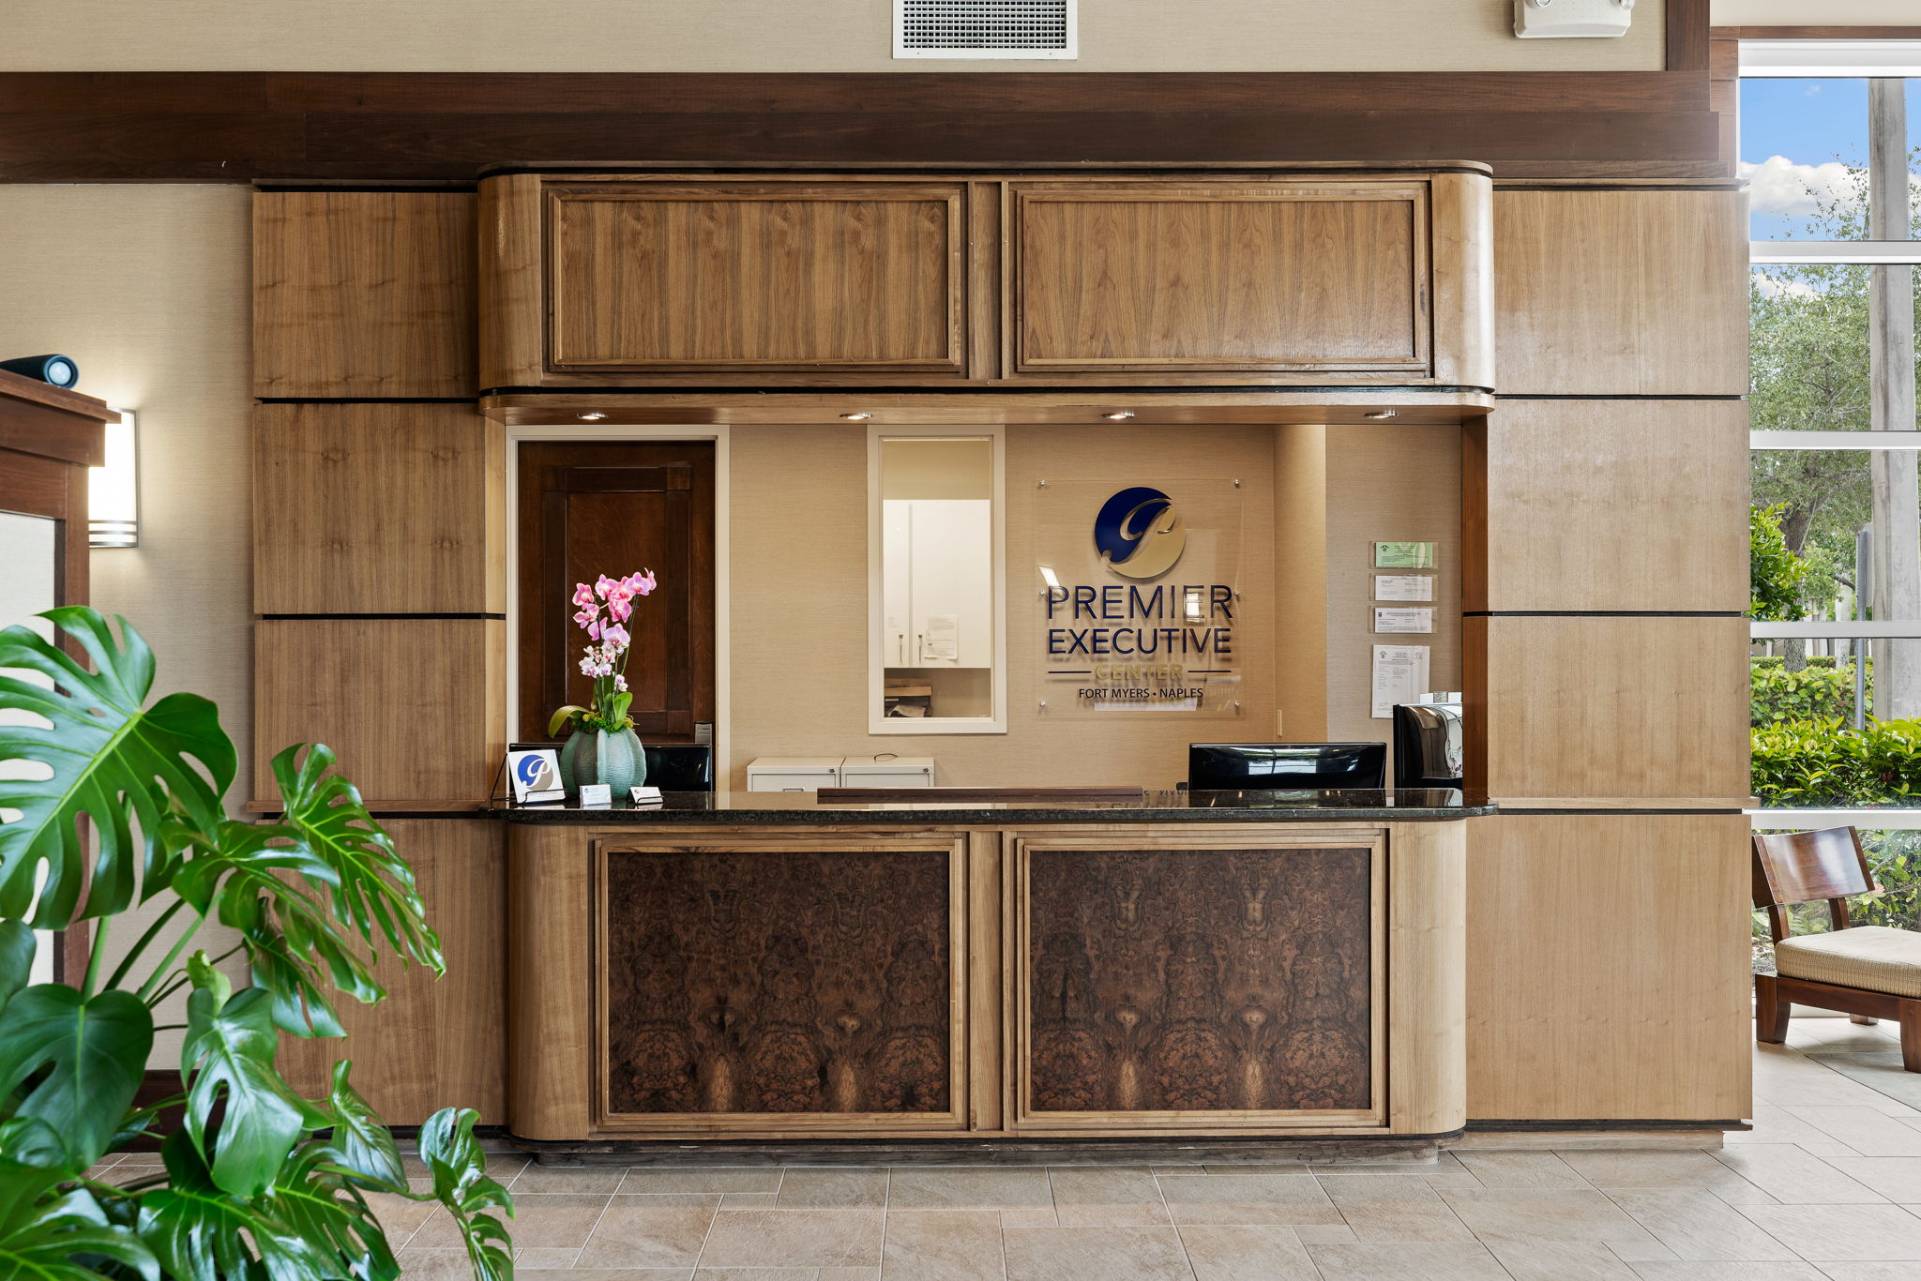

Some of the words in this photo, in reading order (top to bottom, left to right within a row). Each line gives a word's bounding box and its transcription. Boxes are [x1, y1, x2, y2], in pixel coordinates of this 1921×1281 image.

[1047, 585, 1233, 620] PREMIER
[1048, 628, 1232, 655] EXECUTIVE
[1094, 663, 1184, 681] CENTER
[1079, 688, 1107, 698] FORT
[1111, 688, 1150, 698] MYERS
[1160, 688, 1204, 698] NAPLES
